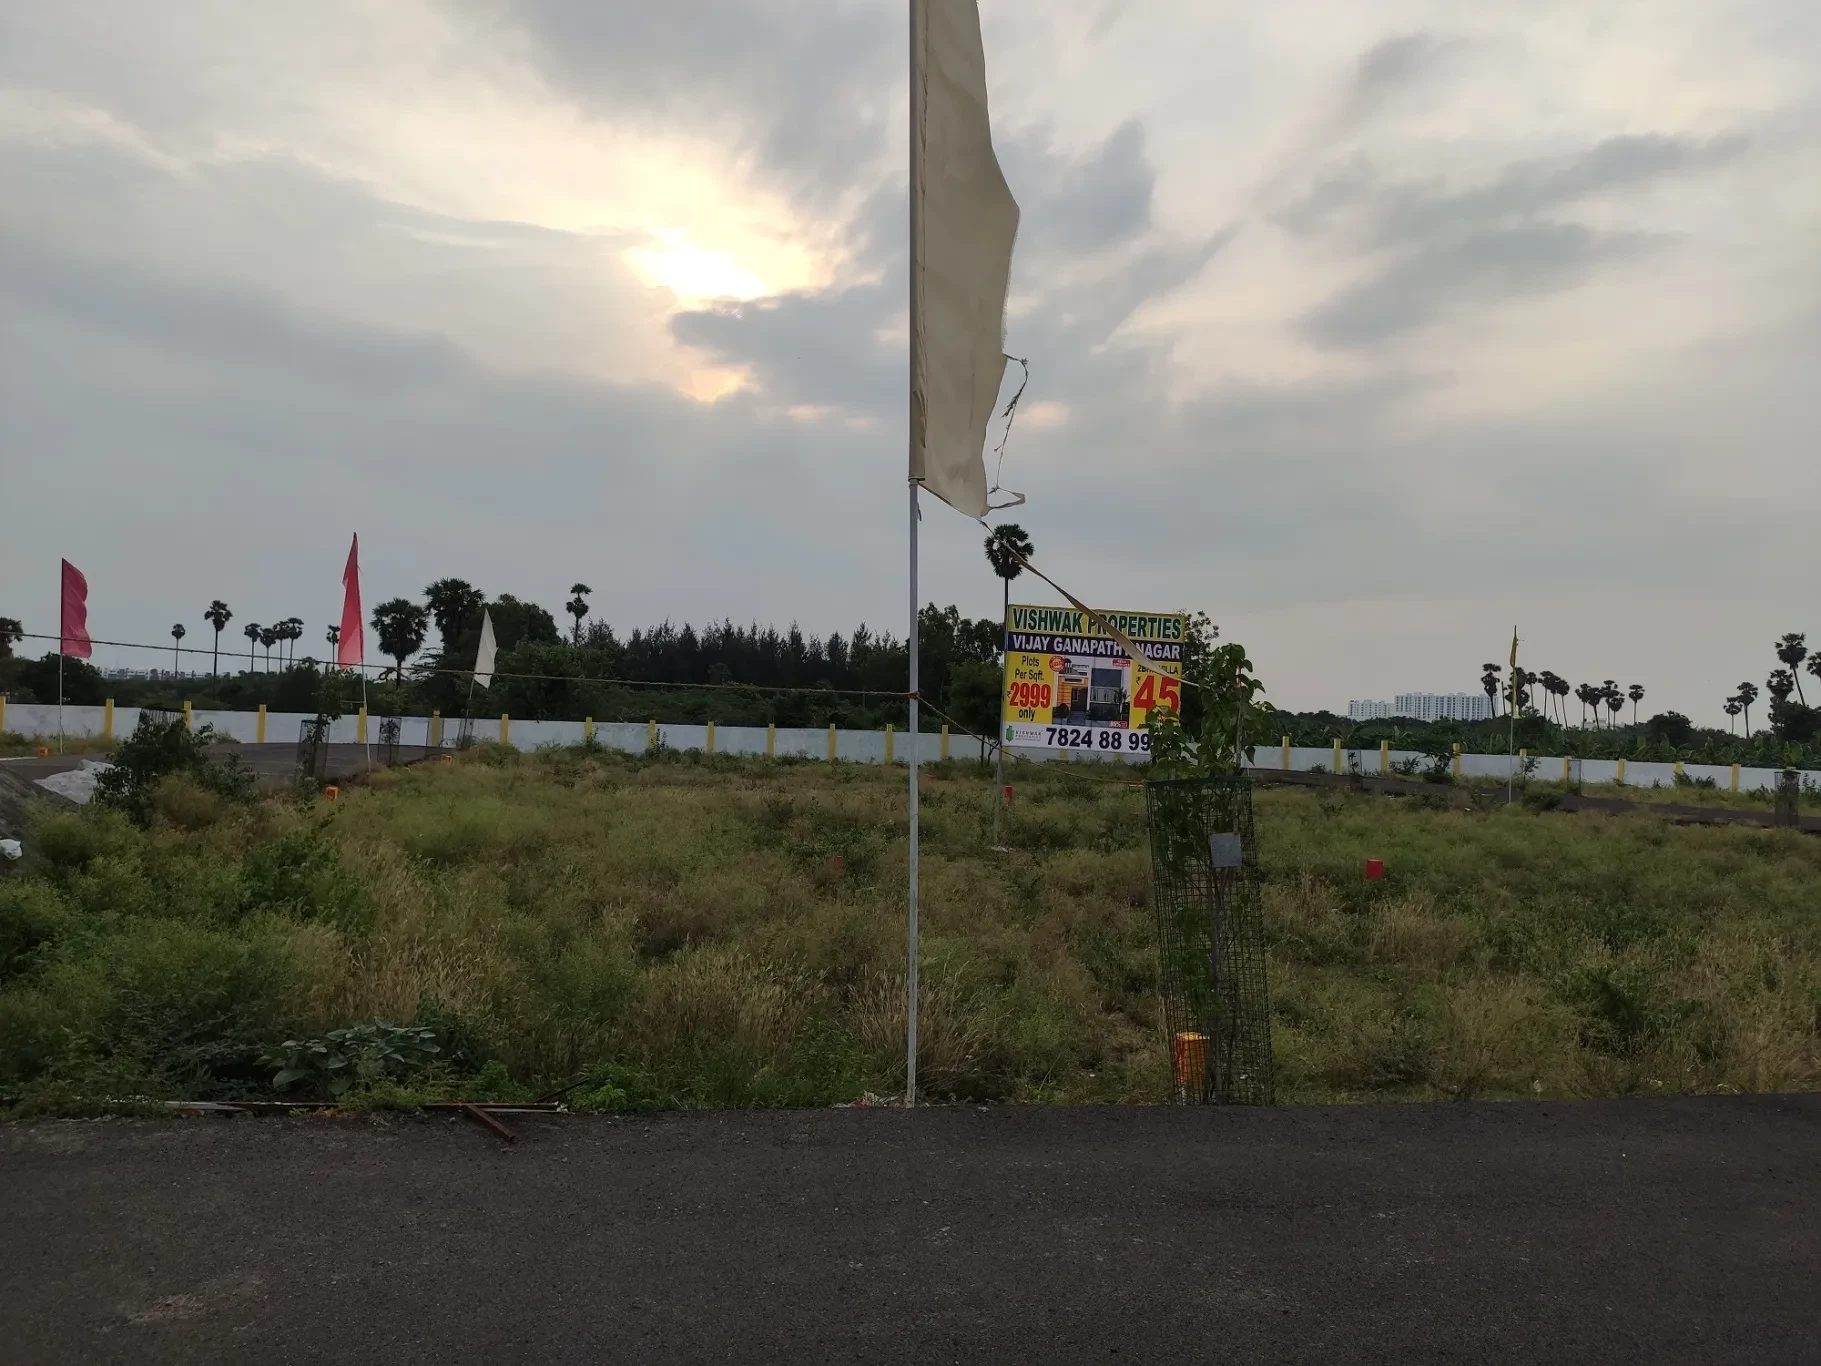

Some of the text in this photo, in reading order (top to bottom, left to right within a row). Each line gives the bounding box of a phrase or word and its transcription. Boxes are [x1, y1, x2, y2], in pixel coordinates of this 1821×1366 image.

[1013, 608, 1181, 640] VISHWAK PROPERTIES
[1013, 634, 1180, 659] VIJAY GANAPATH NAGAR
[1021, 655, 1040, 667] Plots
[1015, 668, 1027, 679] Per
[1018, 707, 1036, 722] only
[1045, 727, 1151, 752] 7824 88 99
